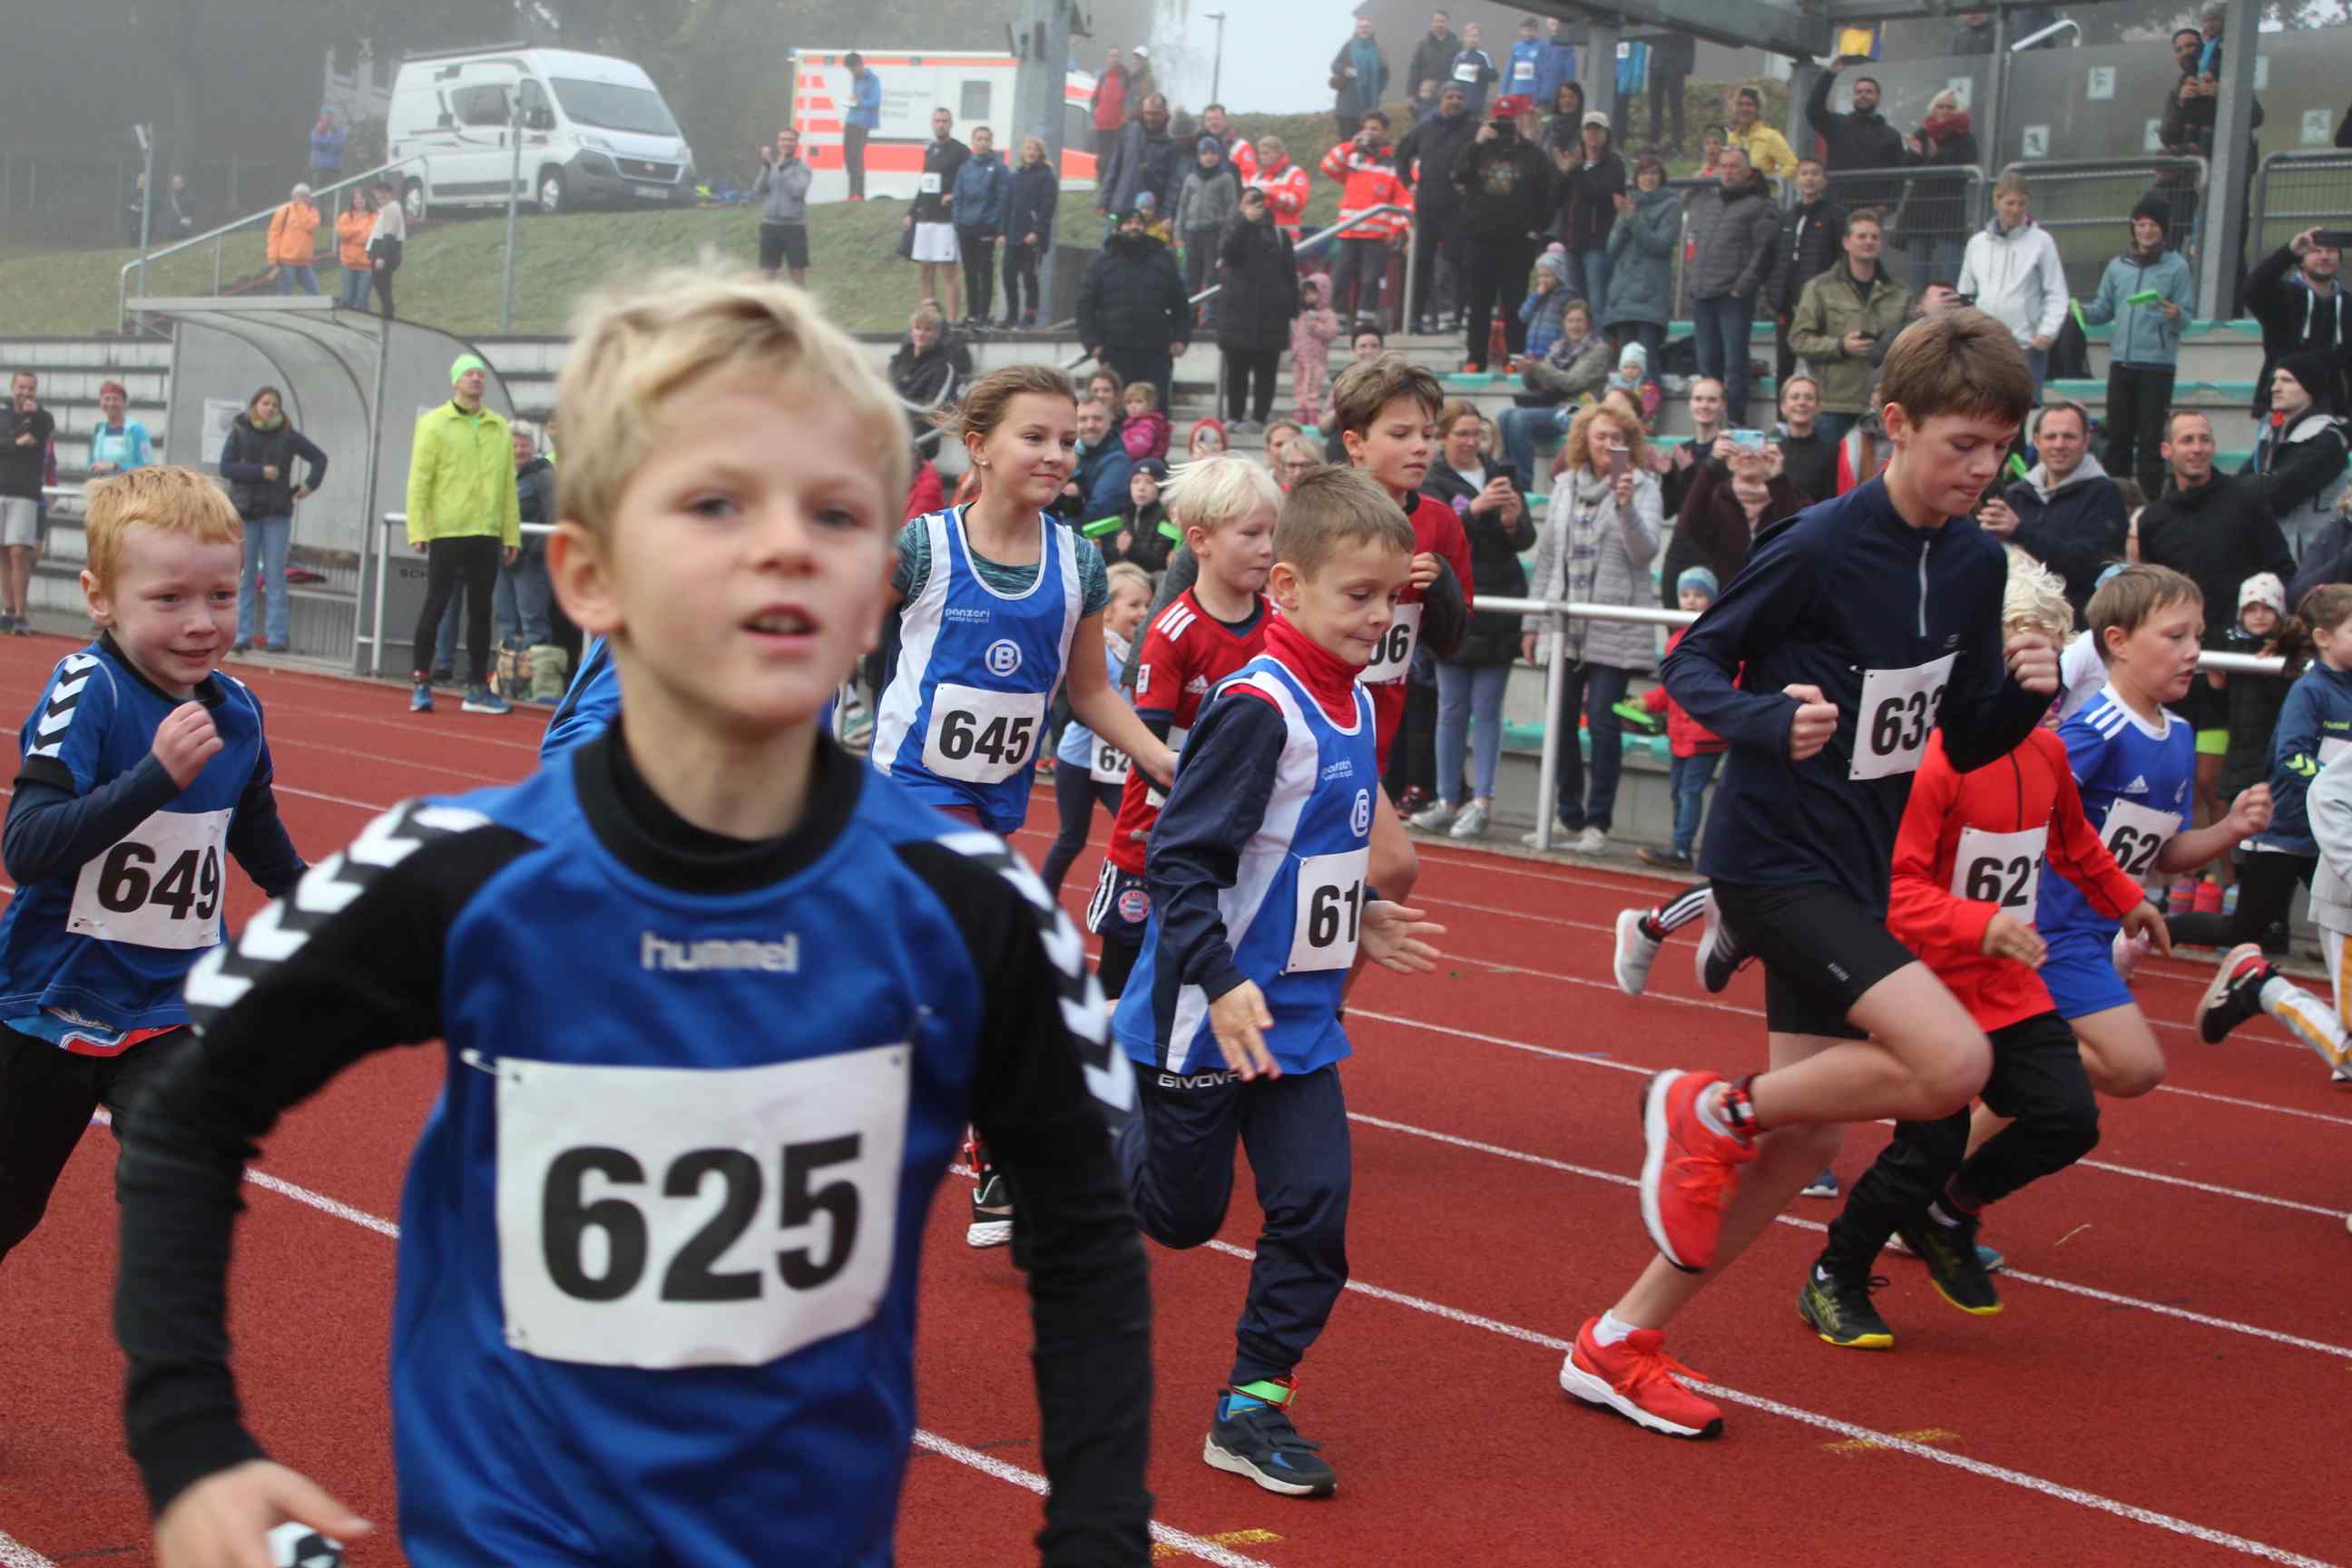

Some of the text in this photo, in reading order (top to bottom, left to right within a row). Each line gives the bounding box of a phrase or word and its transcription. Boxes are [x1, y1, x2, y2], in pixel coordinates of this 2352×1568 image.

[939, 710, 1034, 764] 645
[97, 841, 220, 920] 649
[2108, 825, 2162, 876] 62
[1308, 879, 1359, 948] 61
[640, 930, 799, 974] hummel
[542, 1132, 863, 1303] 625
